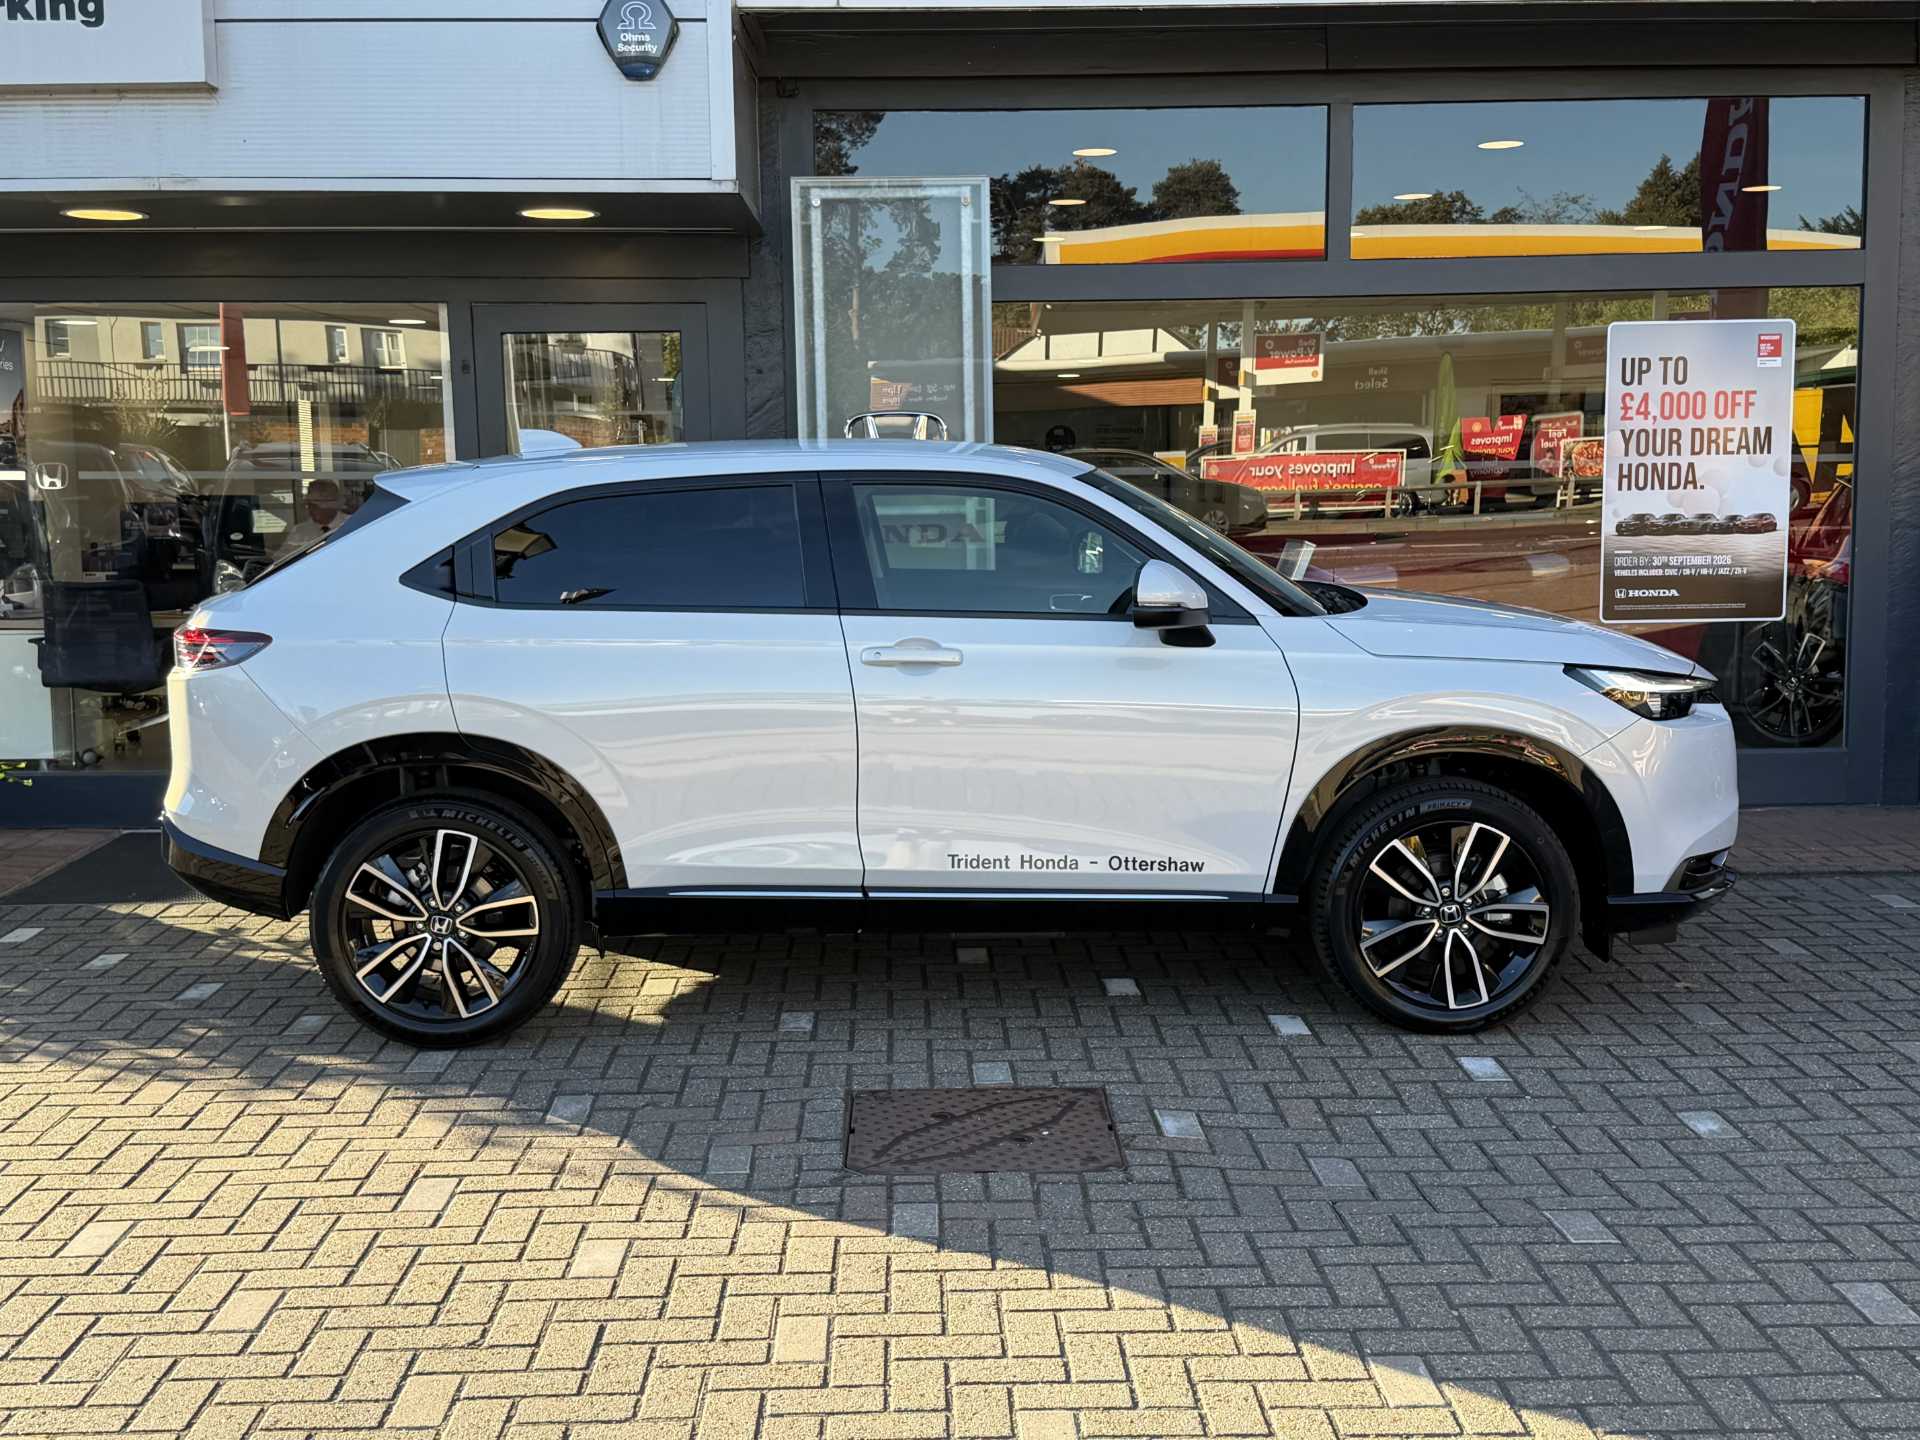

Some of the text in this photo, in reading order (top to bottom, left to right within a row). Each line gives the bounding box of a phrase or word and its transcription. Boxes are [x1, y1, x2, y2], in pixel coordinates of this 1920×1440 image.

[0, 0, 104, 28] king
[617, 43, 658, 54] Security
[620, 32, 651, 42] Ohms
[1620, 356, 1688, 386] UP TO
[1619, 390, 1757, 424] £4,000 OFF
[1620, 426, 1773, 457] YOUR DREAM
[1617, 461, 1705, 491] HONDA.
[1614, 556, 1638, 567] ORDER
[1669, 555, 1712, 566] SEPTEMBER
[1628, 589, 1680, 598] HONDA
[441, 808, 525, 850] MICHELIN
[1349, 807, 1416, 867] MICHELIN
[947, 854, 1010, 870] Trident
[1020, 854, 1079, 870] Honda
[1108, 855, 1205, 872] Ottershaw
